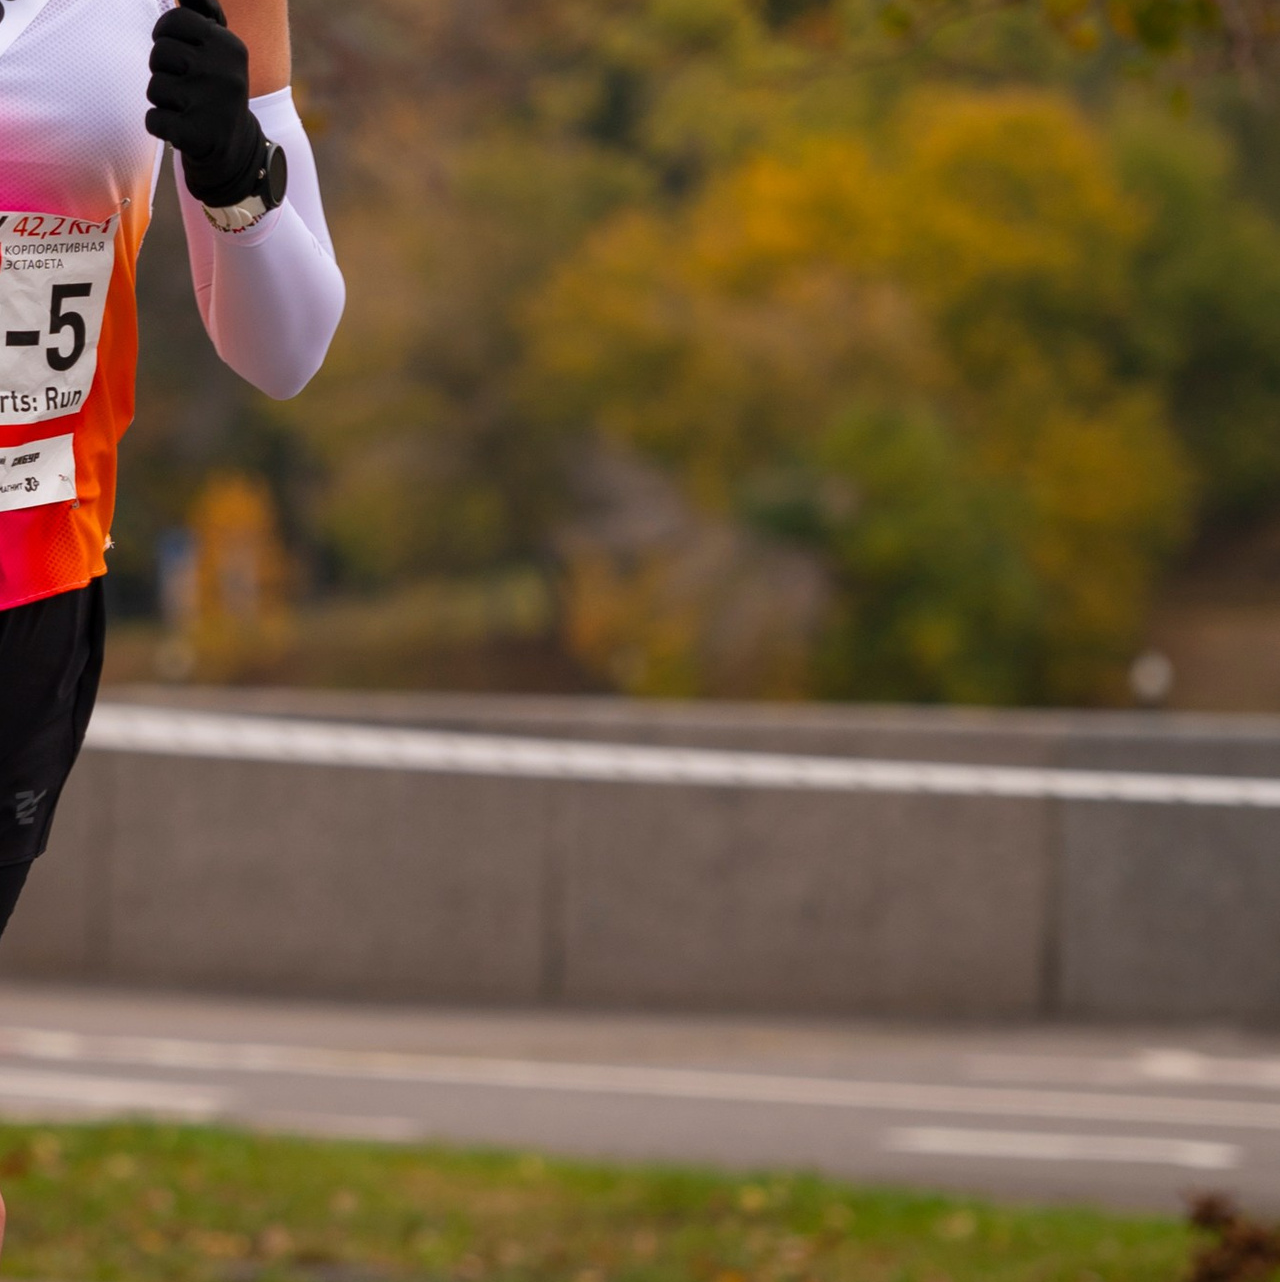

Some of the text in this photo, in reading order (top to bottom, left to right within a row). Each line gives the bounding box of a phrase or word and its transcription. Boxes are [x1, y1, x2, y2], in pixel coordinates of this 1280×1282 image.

[12, 215, 67, 240] 42,2
[4, 241, 106, 256] КОРПОРАТИВНАЯ
[3, 258, 65, 271] ЭСТАФЕТА
[45, 386, 83, 412] Run
